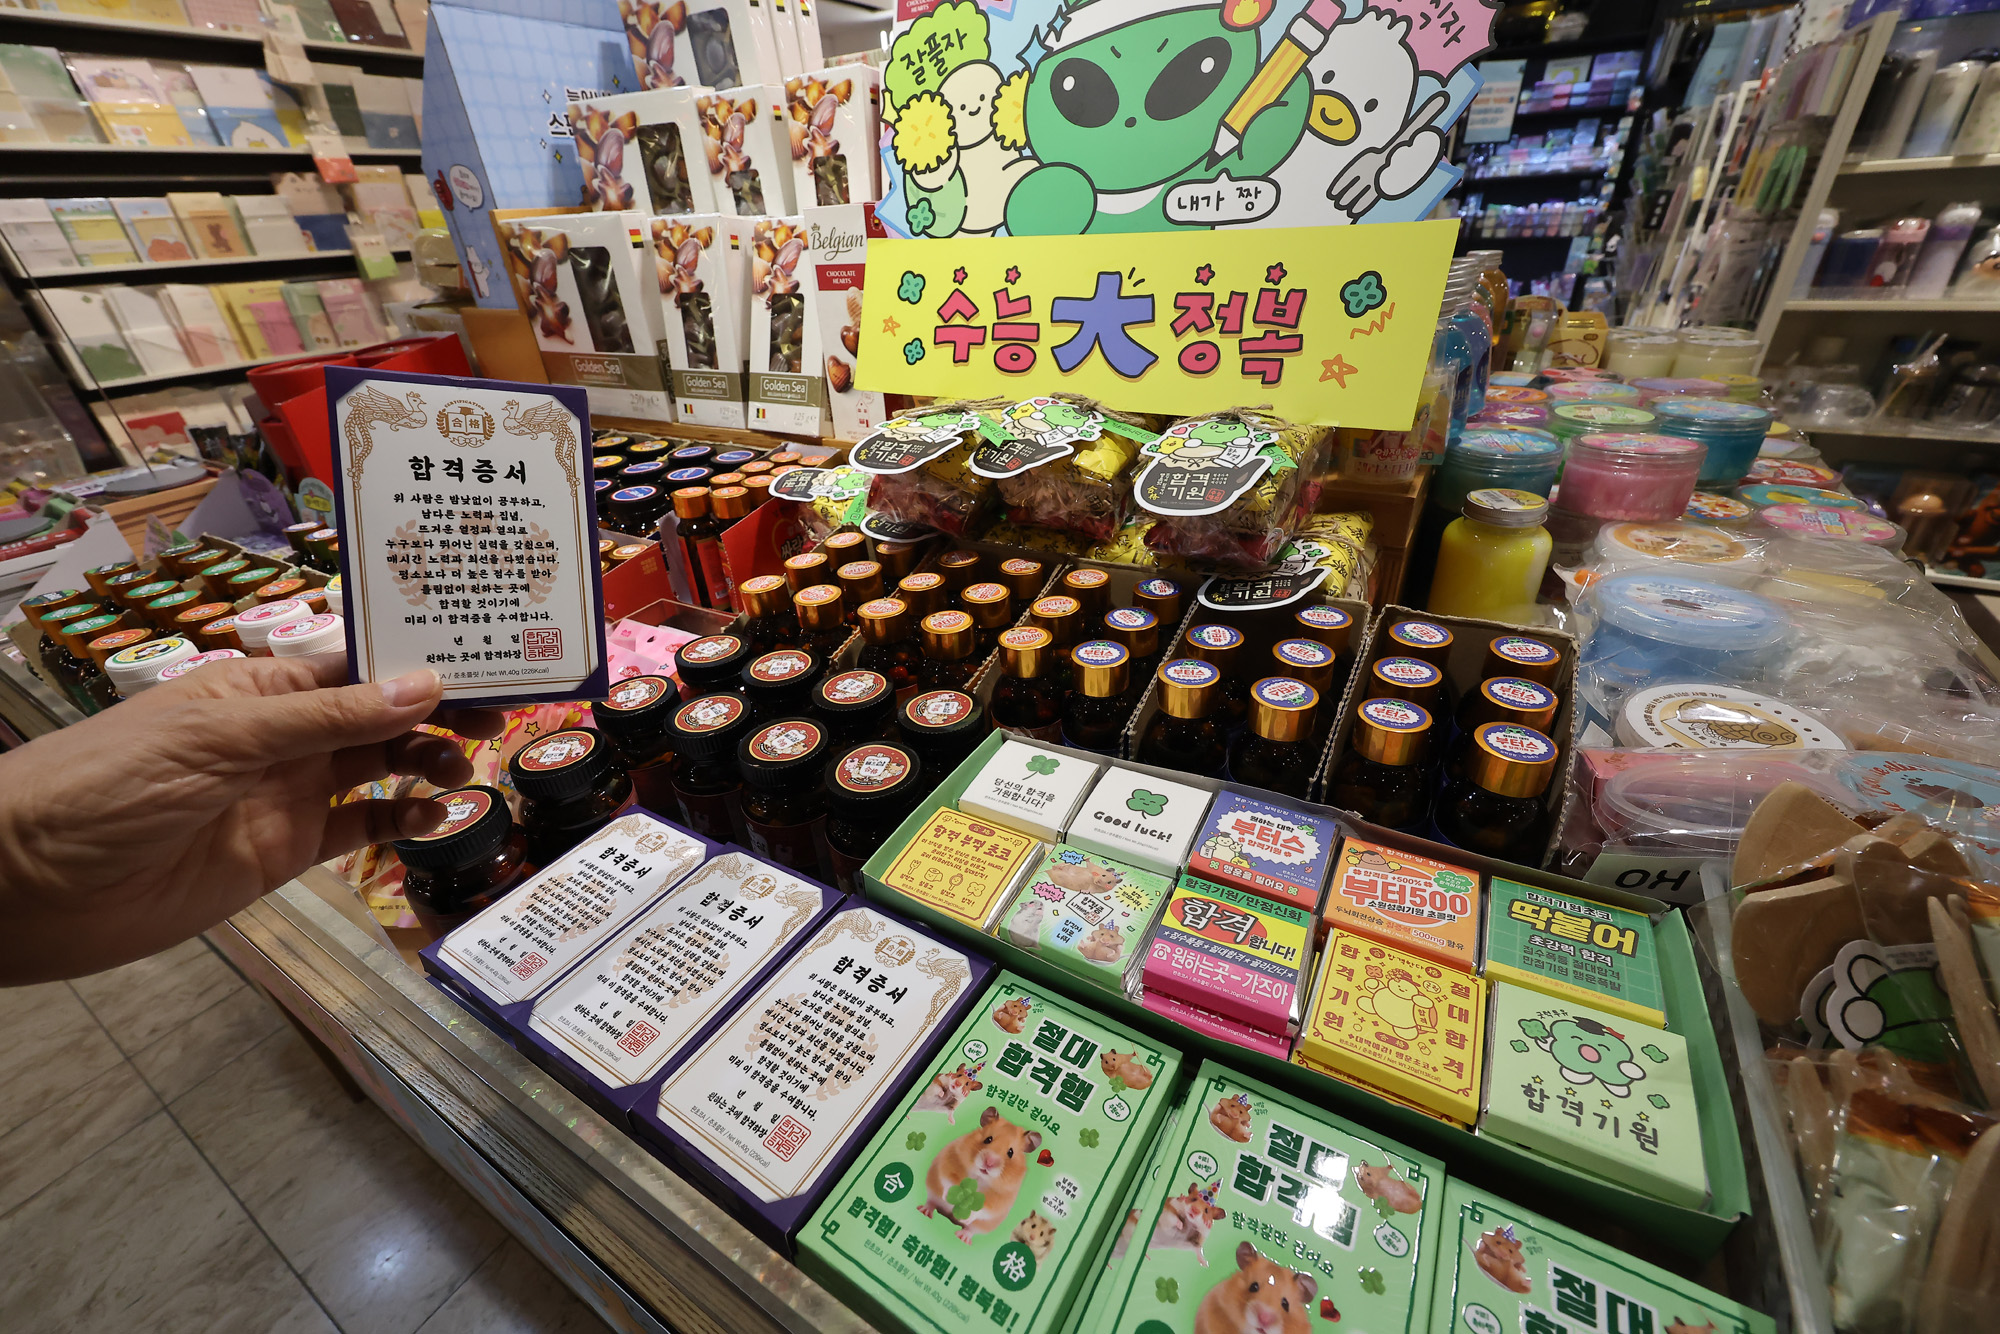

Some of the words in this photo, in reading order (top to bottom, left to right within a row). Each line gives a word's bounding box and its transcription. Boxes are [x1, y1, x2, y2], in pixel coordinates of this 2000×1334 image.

[911, 5, 929, 13] HEARTS
[900, 28, 967, 85] 잘풀자
[1177, 188, 1223, 213] 내가
[1236, 185, 1263, 213] 짱
[811, 227, 864, 261] Belgian
[933, 287, 1040, 375] 수능
[1051, 271, 1159, 378] 大
[1170, 287, 1307, 387] 정복
[575, 359, 606, 374] Golden
[607, 361, 621, 375] Sea
[686, 376, 711, 389] Golden
[712, 377, 726, 389] Sea
[763, 379, 790, 392] Golden
[791, 381, 806, 394] Sea
[444, 400, 485, 411] CERTIFICATION
[451, 418, 463, 427] 合
[469, 419, 480, 428] 格
[409, 455, 526, 485] 합격증서
[1170, 473, 1210, 486] 합격
[394, 493, 403, 503] 위
[410, 494, 444, 504] 사람은
[449, 495, 493, 506] 밤낮없이
[498, 497, 546, 508] 공부하고,
[1168, 487, 1206, 500] 기원
[422, 509, 455, 520] 남다른
[461, 510, 494, 520] 노력과
[499, 511, 523, 522] 집념,
[418, 525, 453, 534] 뜨거운
[459, 525, 491, 535] 열정과
[496, 526, 528, 535] 열의로
[386, 539, 434, 549] 누구보다
[439, 540, 473, 549] 뛰어난
[478, 540, 508, 550] 실력을
[387, 555, 422, 564] 매시간
[428, 555, 462, 564] 노력과
[468, 555, 499, 564] 최선을
[504, 555, 560, 565] 다했습니다.
[399, 570, 446, 580] 평소보다
[452, 570, 461, 579] 더
[467, 570, 489, 580] 높은
[494, 569, 525, 580] 점수를
[531, 569, 552, 579] 받아
[421, 584, 465, 594] 틀림없이
[471, 584, 503, 594] 원하는
[509, 583, 530, 594] 곳에
[439, 599, 471, 609] 합격할
[477, 598, 520, 609] 것이기에
[405, 615, 426, 625] 미리
[433, 614, 442, 624] 이
[448, 613, 491, 624] 합격증을
[497, 612, 553, 622] 수여합니다.
[934, 615, 966, 627] 부터500
[454, 635, 463, 645] 년
[483, 635, 492, 645] 월
[511, 634, 520, 643] 일
[1005, 633, 1043, 644] 부터500
[426, 653, 456, 663] 원하는
[460, 651, 480, 662] 곳에
[484, 650, 521, 661] 합격하장
[1289, 645, 1317, 659] 부터스
[1507, 646, 1543, 654] 부터스
[1173, 668, 1205, 677] 부터스
[1389, 667, 1425, 675] 부터스
[1499, 686, 1537, 701] 부터스
[1374, 708, 1411, 720] 부터스
[1496, 737, 1539, 750] 부터스
[992, 787, 1046, 809] 기원합니다!
[994, 778, 1023, 792] 당신의
[1026, 787, 1056, 802] 합격을
[1094, 811, 1131, 829] Good
[1134, 823, 1173, 842] luck!
[1250, 815, 1275, 827] 원하는
[1276, 823, 1294, 833] 대학
[934, 824, 962, 843] 합격
[960, 834, 987, 852] 부적
[983, 844, 1011, 861] 초코
[1232, 818, 1305, 854] 부터스
[1248, 840, 1282, 856] 합격기원
[598, 847, 652, 880] 합격증서
[1223, 864, 1252, 880] 행운을
[1255, 875, 1284, 892] 빌어요
[1391, 875, 1422, 886] +500%
[961, 897, 975, 907] 합격!
[1185, 877, 1303, 922] 합격기원/만점신화
[1343, 875, 1468, 915] 부터500
[700, 891, 764, 930] 합격증서
[1368, 900, 1424, 916] 소원성취기원
[1426, 910, 1456, 922] 초콜릿
[1526, 892, 1613, 922] 합격기원초코
[1061, 926, 1075, 937] 바로
[1063, 919, 1083, 932] 합격자
[1181, 896, 1260, 945] 합격
[1249, 934, 1296, 962] 합니다!
[1335, 905, 1384, 926] 두뇌회전상승
[1413, 929, 1446, 946] 500mg
[1447, 939, 1465, 951] 함유
[1387, 953, 1425, 970] 합격한다
[1529, 935, 1575, 956] 초강력
[1580, 948, 1613, 967] 합격
[1523, 945, 1568, 965] 점수폭등
[1573, 956, 1620, 980] 절대합격
[833, 955, 908, 1005] 합격증서
[1171, 946, 1230, 984] 원하는곳
[1242, 971, 1289, 1005] 가즈아
[1523, 956, 1569, 977] 만점기원
[1572, 970, 1622, 992] 행운폭발
[1323, 943, 1361, 1032] 합격기원
[816, 977, 838, 992] 사람은
[837, 988, 865, 1008] 밤낮없이
[864, 1005, 896, 1029] 공부하고,
[1442, 980, 1471, 1080] 절대합격
[1032, 1018, 1100, 1070] 절대
[995, 1040, 1095, 1113] 합격햄
[707, 1091, 728, 1109] 원하는
[726, 1105, 744, 1120] 곳에
[740, 1114, 770, 1139] 합격하장
[779, 1090, 817, 1122] 수여합니다.
[985, 1084, 1029, 1112] 합격길만
[1029, 1106, 1061, 1136] 걸어요
[1521, 1083, 1659, 1156] 합격기원
[728, 1131, 738, 1141] Net
[882, 1172, 905, 1195] 合
[1232, 1210, 1289, 1249] 합격길만
[847, 1195, 902, 1244] 합격햄!
[901, 1233, 959, 1287] 축하햄!
[958, 1274, 1020, 1334] 행복햄!
[999, 1250, 1026, 1283] 格
[1552, 1265, 1654, 1334] 절대
